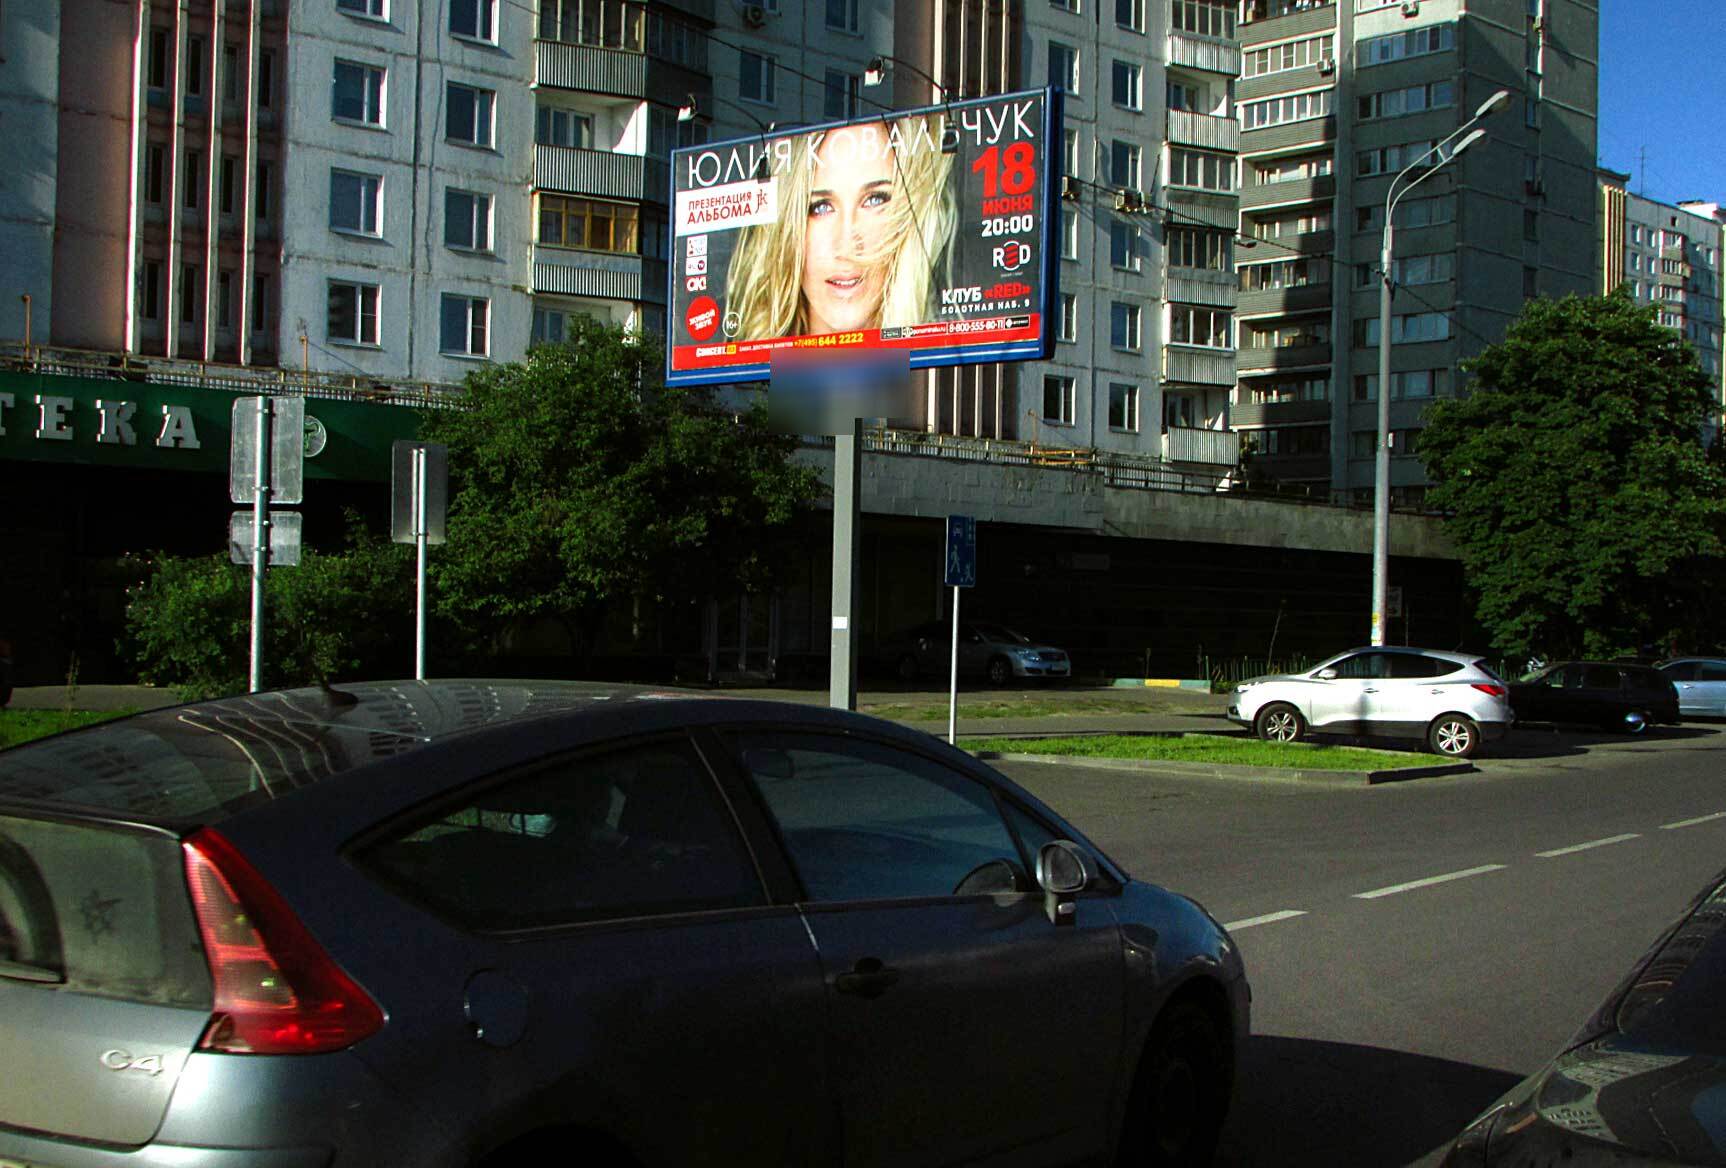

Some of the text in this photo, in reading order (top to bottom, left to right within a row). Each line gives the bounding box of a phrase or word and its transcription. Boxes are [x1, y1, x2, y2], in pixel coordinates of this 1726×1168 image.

[688, 100, 1034, 189] ЮЛИЯ КОВАЛЬЧУК
[972, 141, 1036, 198] 18
[688, 191, 752, 211] ПРЕЗЕНТАЦИЯ
[982, 194, 1033, 218] ИЮНЯ
[687, 203, 752, 225] АЛЬБОМА
[981, 214, 1034, 238] 20:00
[942, 286, 982, 305] КЛУБ
[941, 302, 994, 315] БОЛОТНАЯ
[997, 300, 1021, 310] НАБ.
[819, 335, 837, 346] 644
[839, 332, 864, 345] 2222
[100, 1049, 163, 1076] C4
